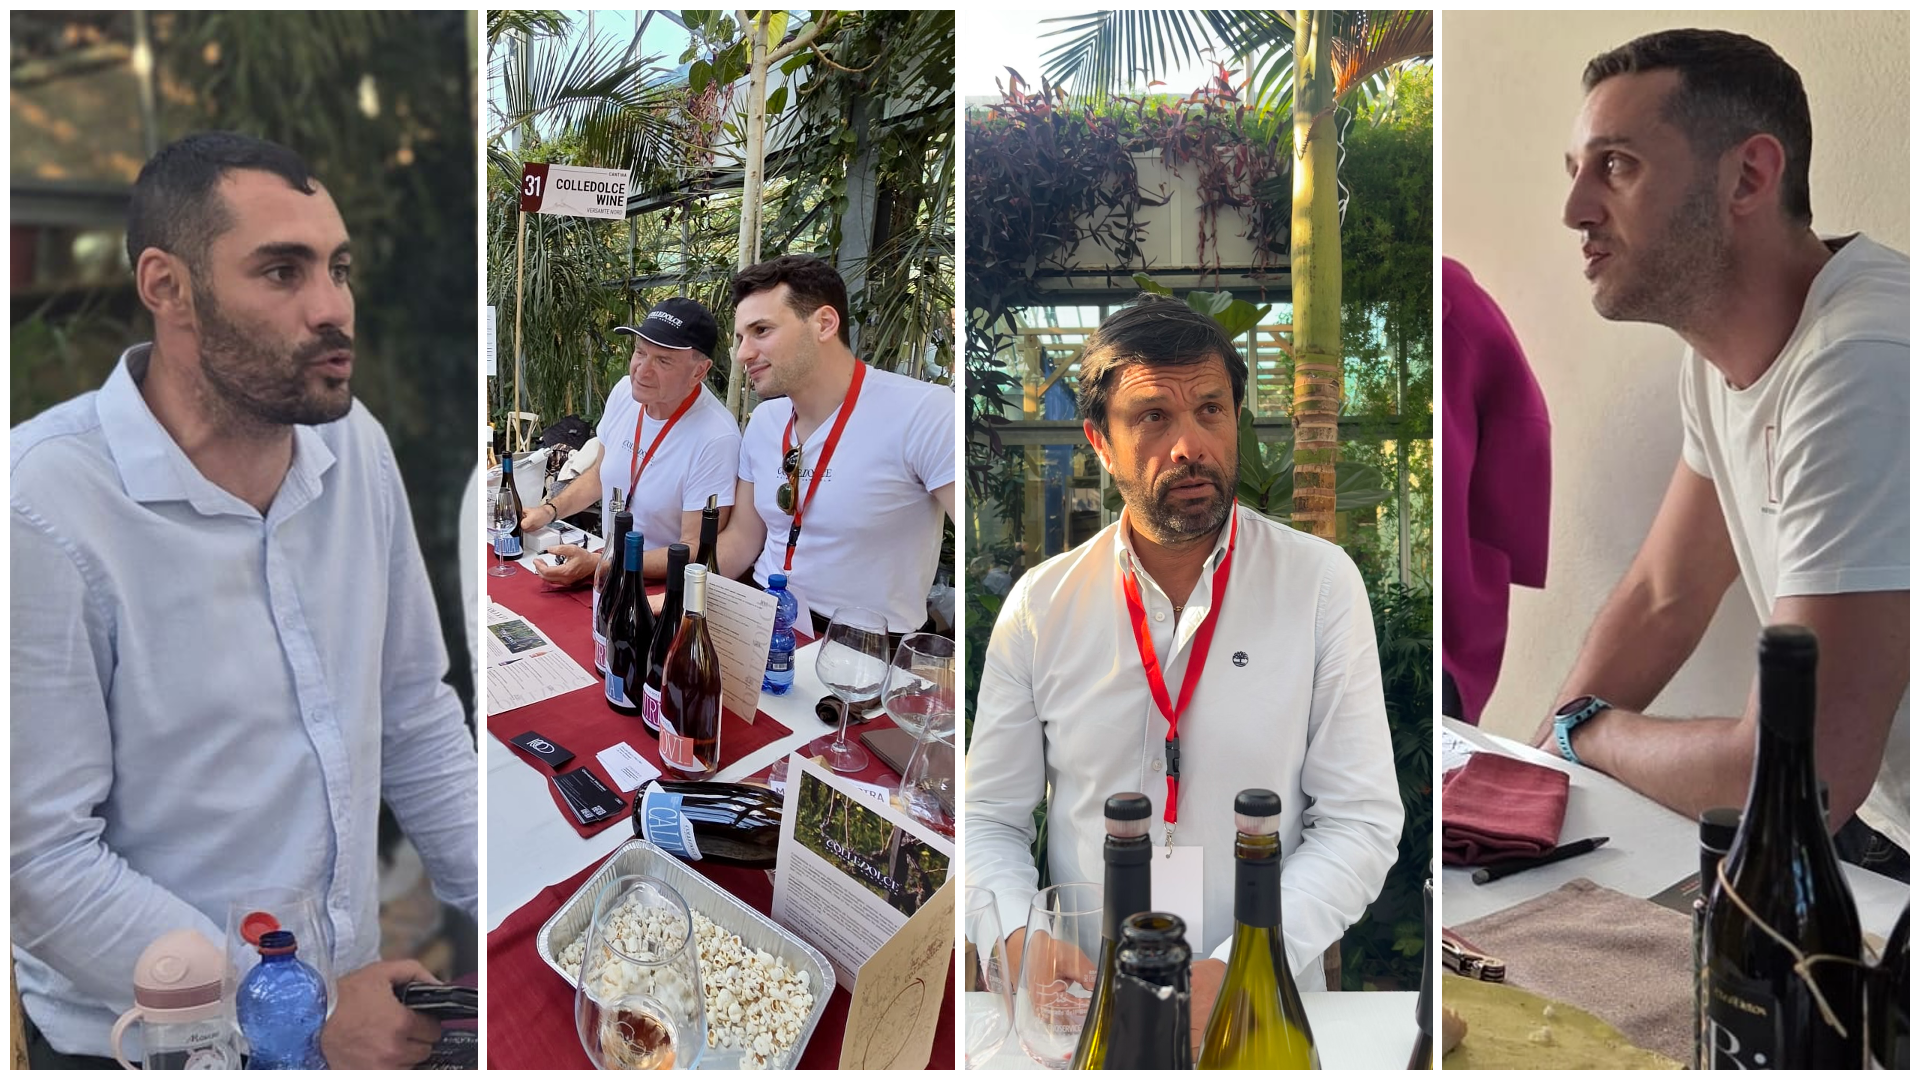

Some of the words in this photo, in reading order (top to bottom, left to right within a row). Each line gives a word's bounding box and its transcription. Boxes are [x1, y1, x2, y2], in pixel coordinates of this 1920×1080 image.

[524, 174, 541, 197] 31
[556, 178, 626, 195] COLLEDOLCE
[596, 193, 625, 207] WINE
[586, 207, 610, 215] VERSANTE
[826, 839, 900, 893] COLLEDOLCE
